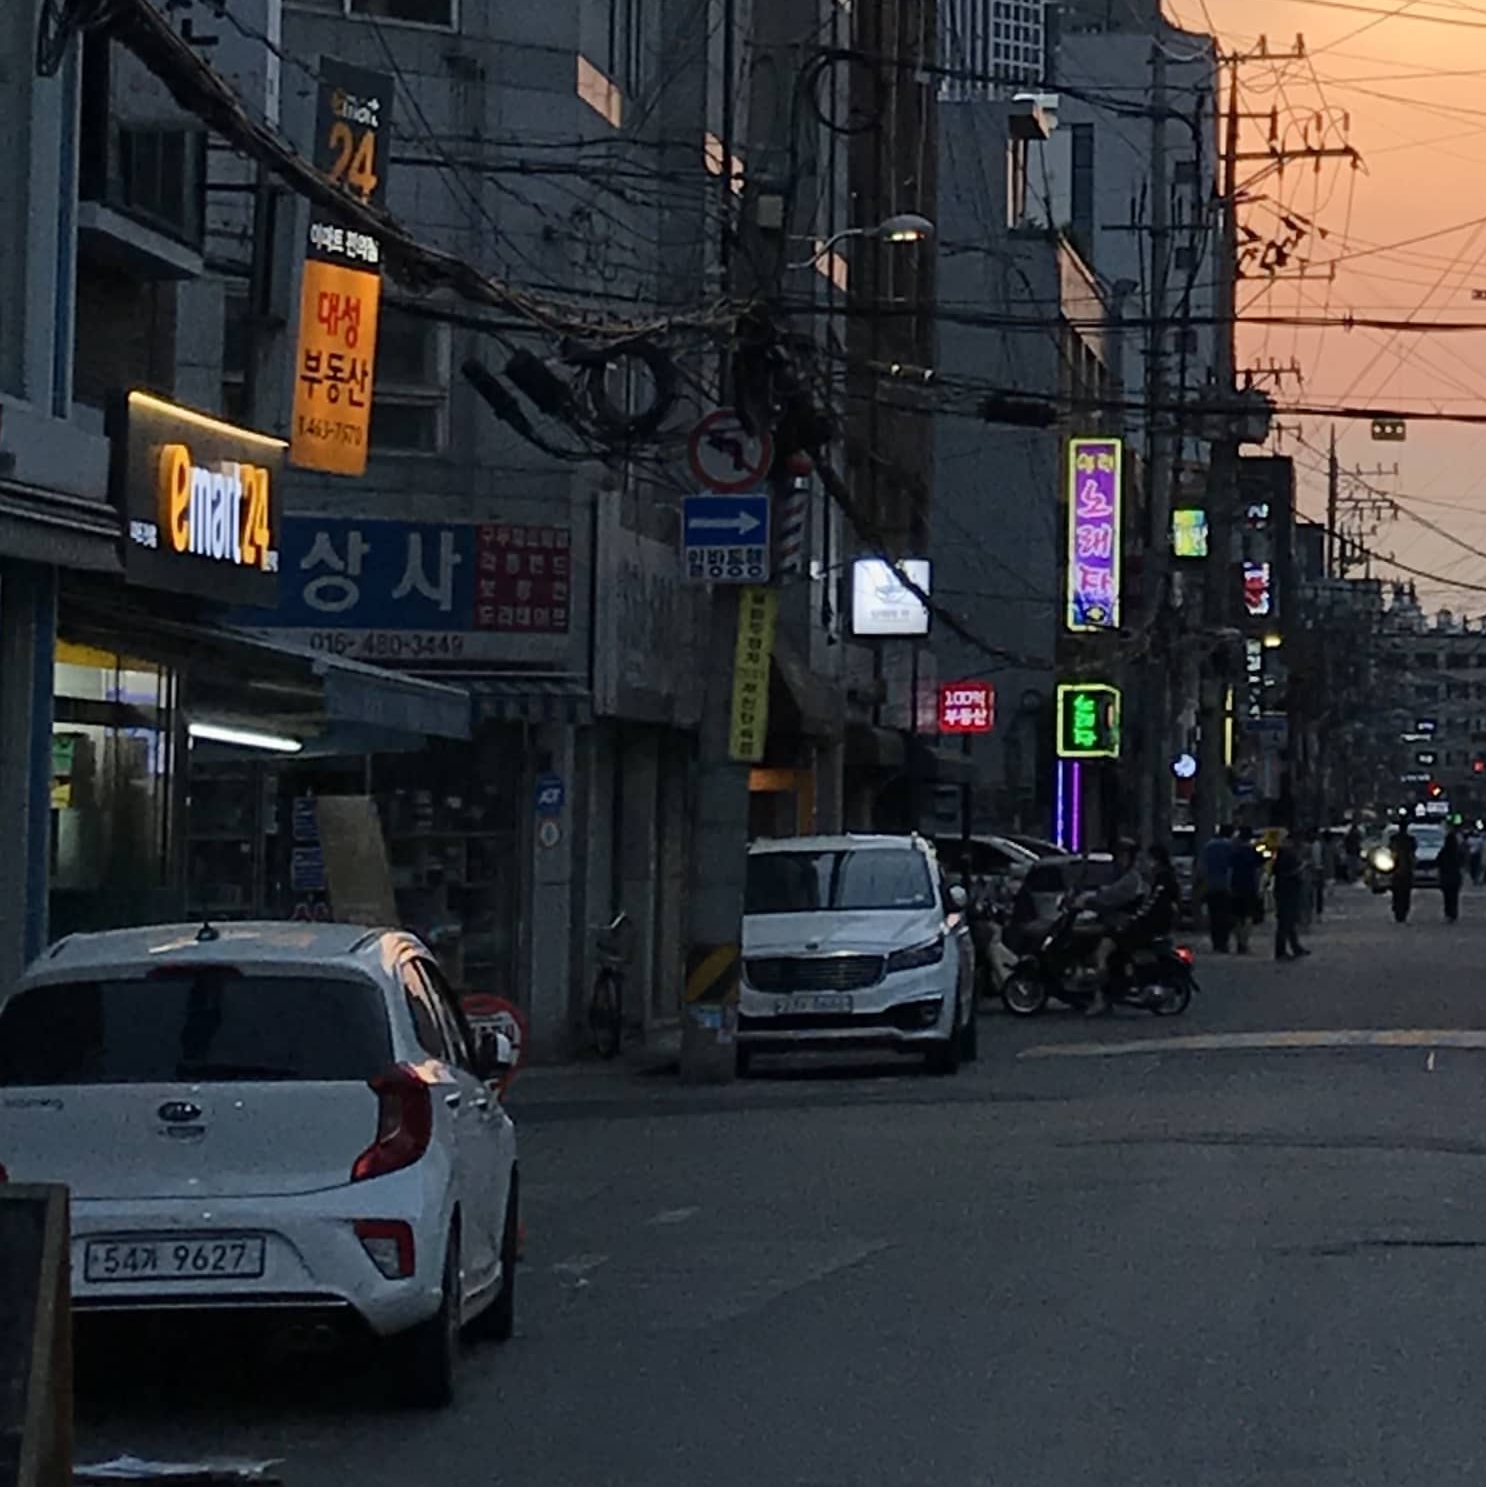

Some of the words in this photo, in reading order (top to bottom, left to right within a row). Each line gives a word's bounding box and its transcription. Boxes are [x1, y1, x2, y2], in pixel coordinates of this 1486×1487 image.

[317, 291, 361, 349] 대성
[300, 348, 369, 408] 부동산
[688, 547, 763, 578] 일방통행
[172, 1244, 247, 1272] 9627
